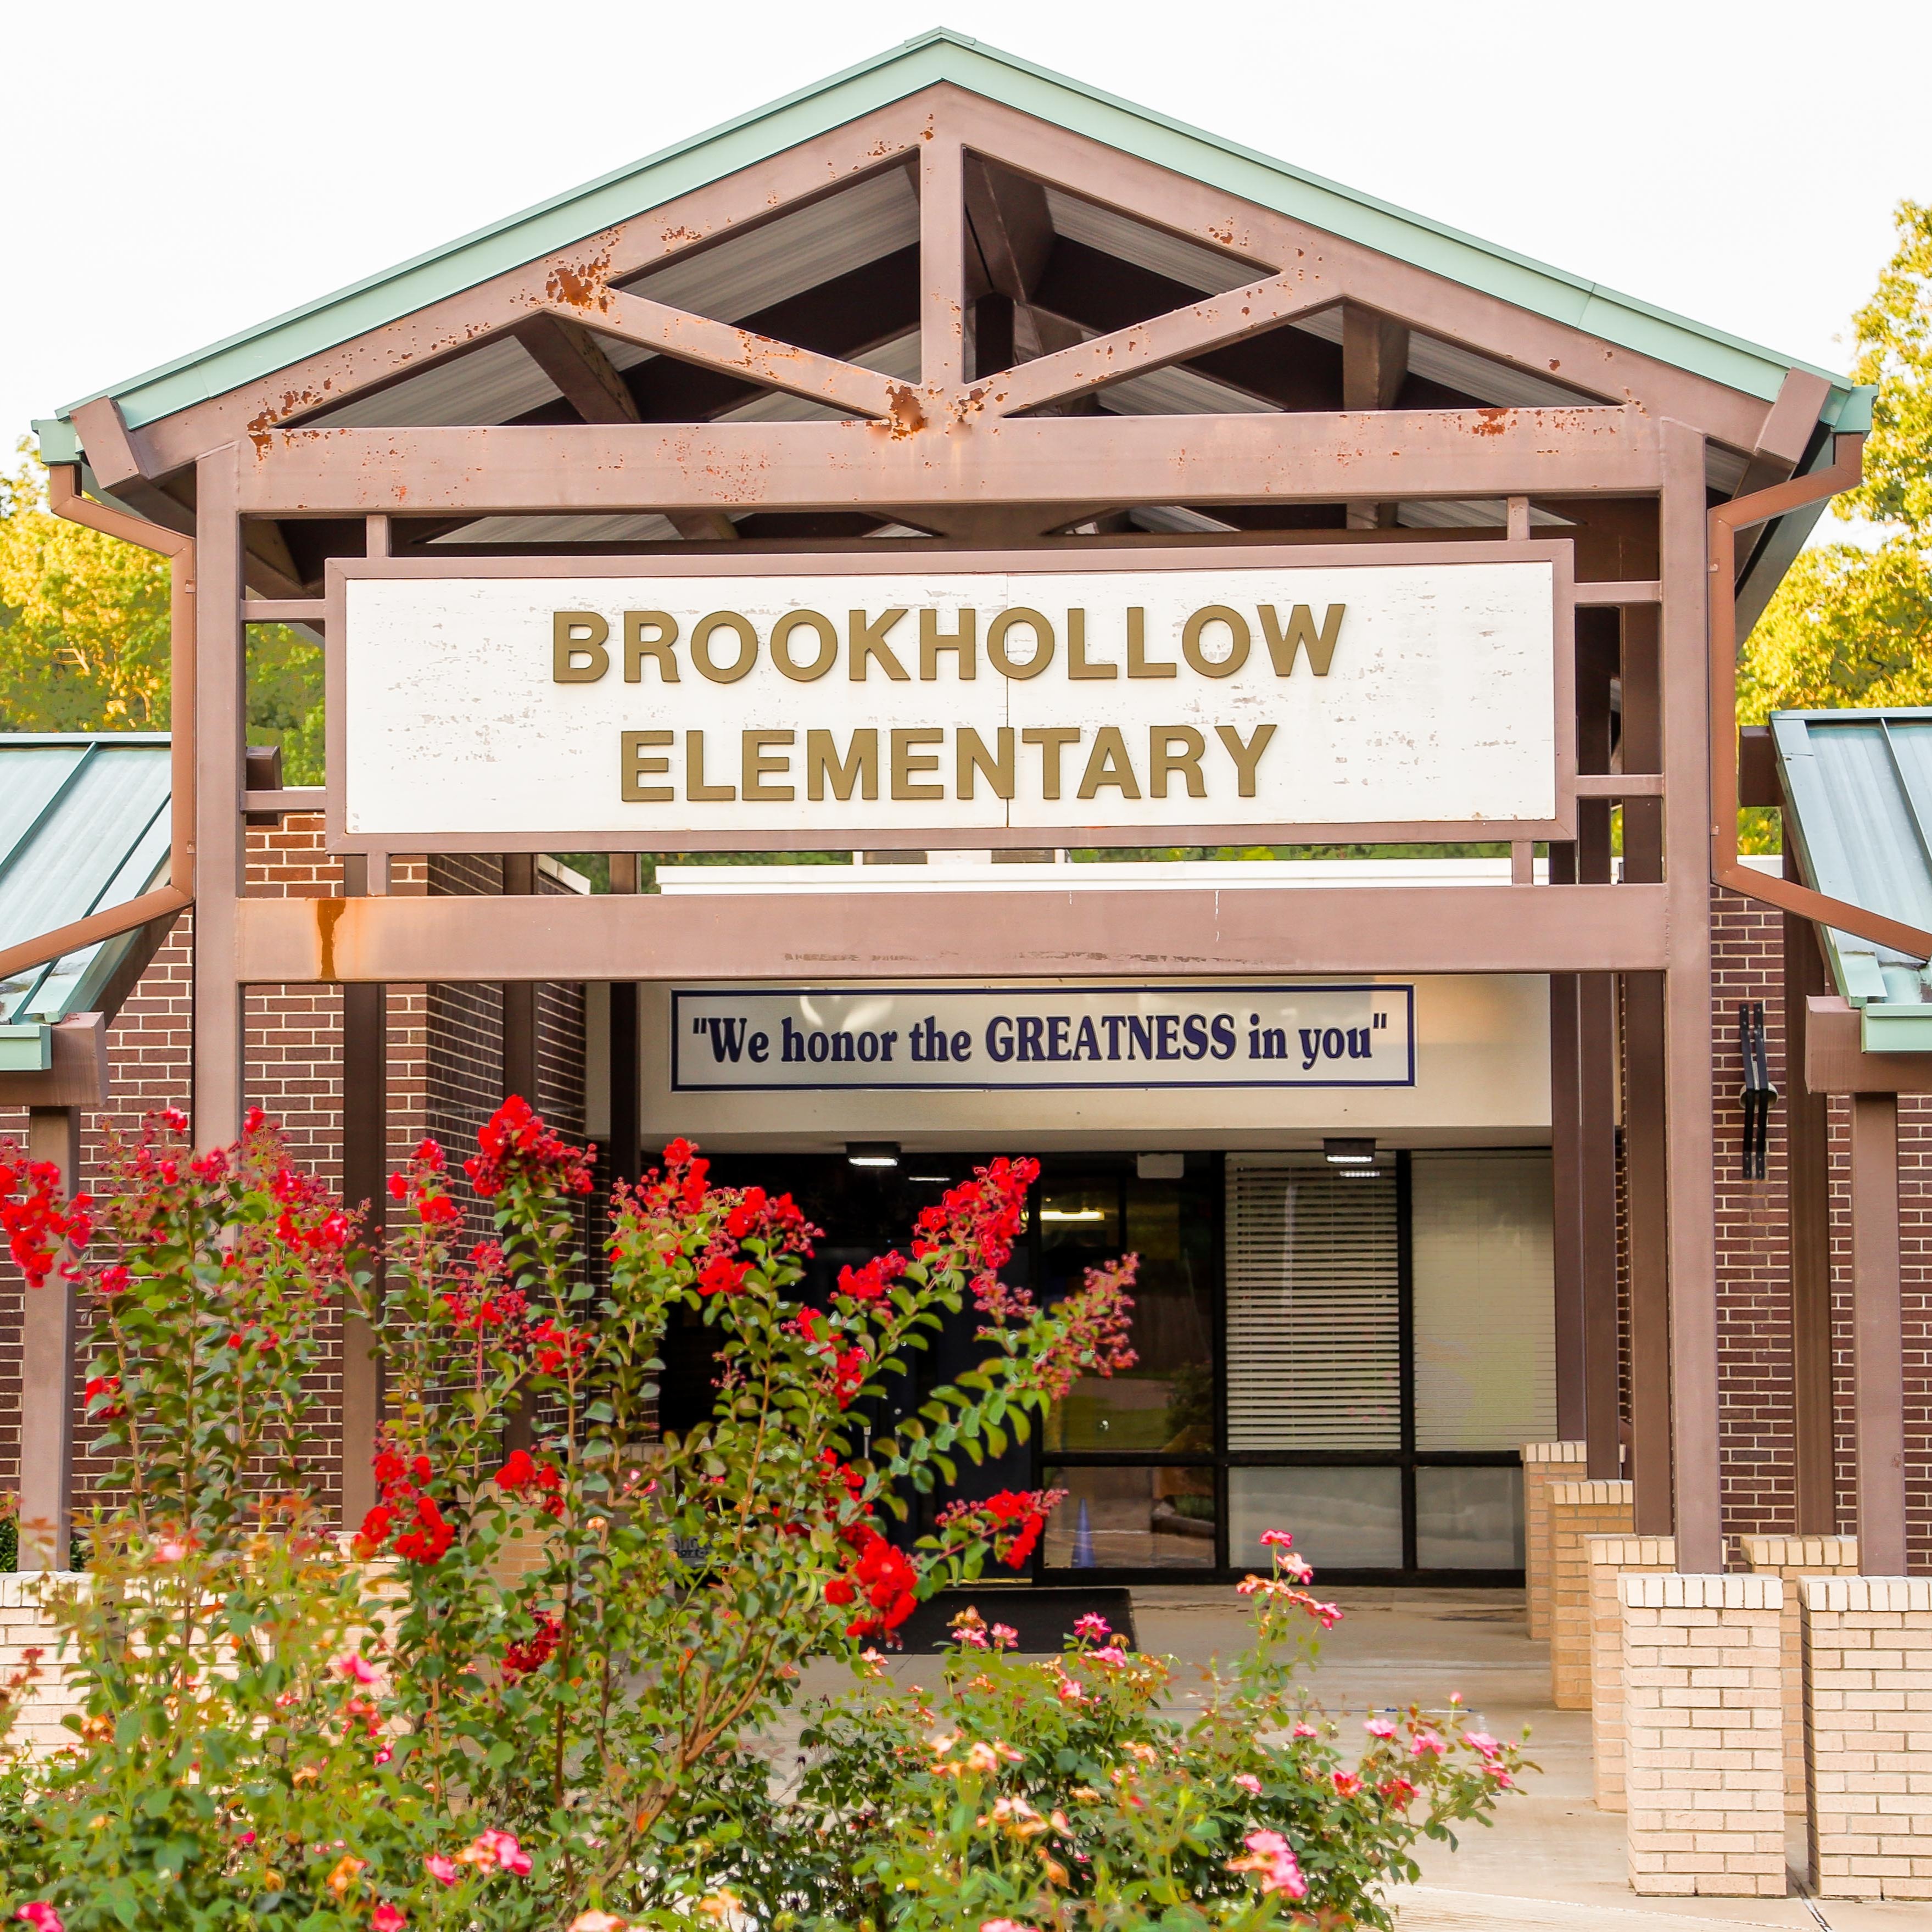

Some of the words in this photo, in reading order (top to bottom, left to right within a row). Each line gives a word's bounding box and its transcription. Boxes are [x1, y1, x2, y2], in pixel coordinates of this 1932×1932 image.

[553, 604, 1345, 684] BROOKHOLLOW
[621, 725, 1277, 803] ELEMENTARY
[693, 1017, 769, 1063] "We
[780, 1016, 898, 1063] honor
[908, 1015, 971, 1062] the
[985, 1014, 1237, 1062] GREATNESS
[1248, 1013, 1288, 1059] in
[1298, 1013, 1387, 1070] you"
